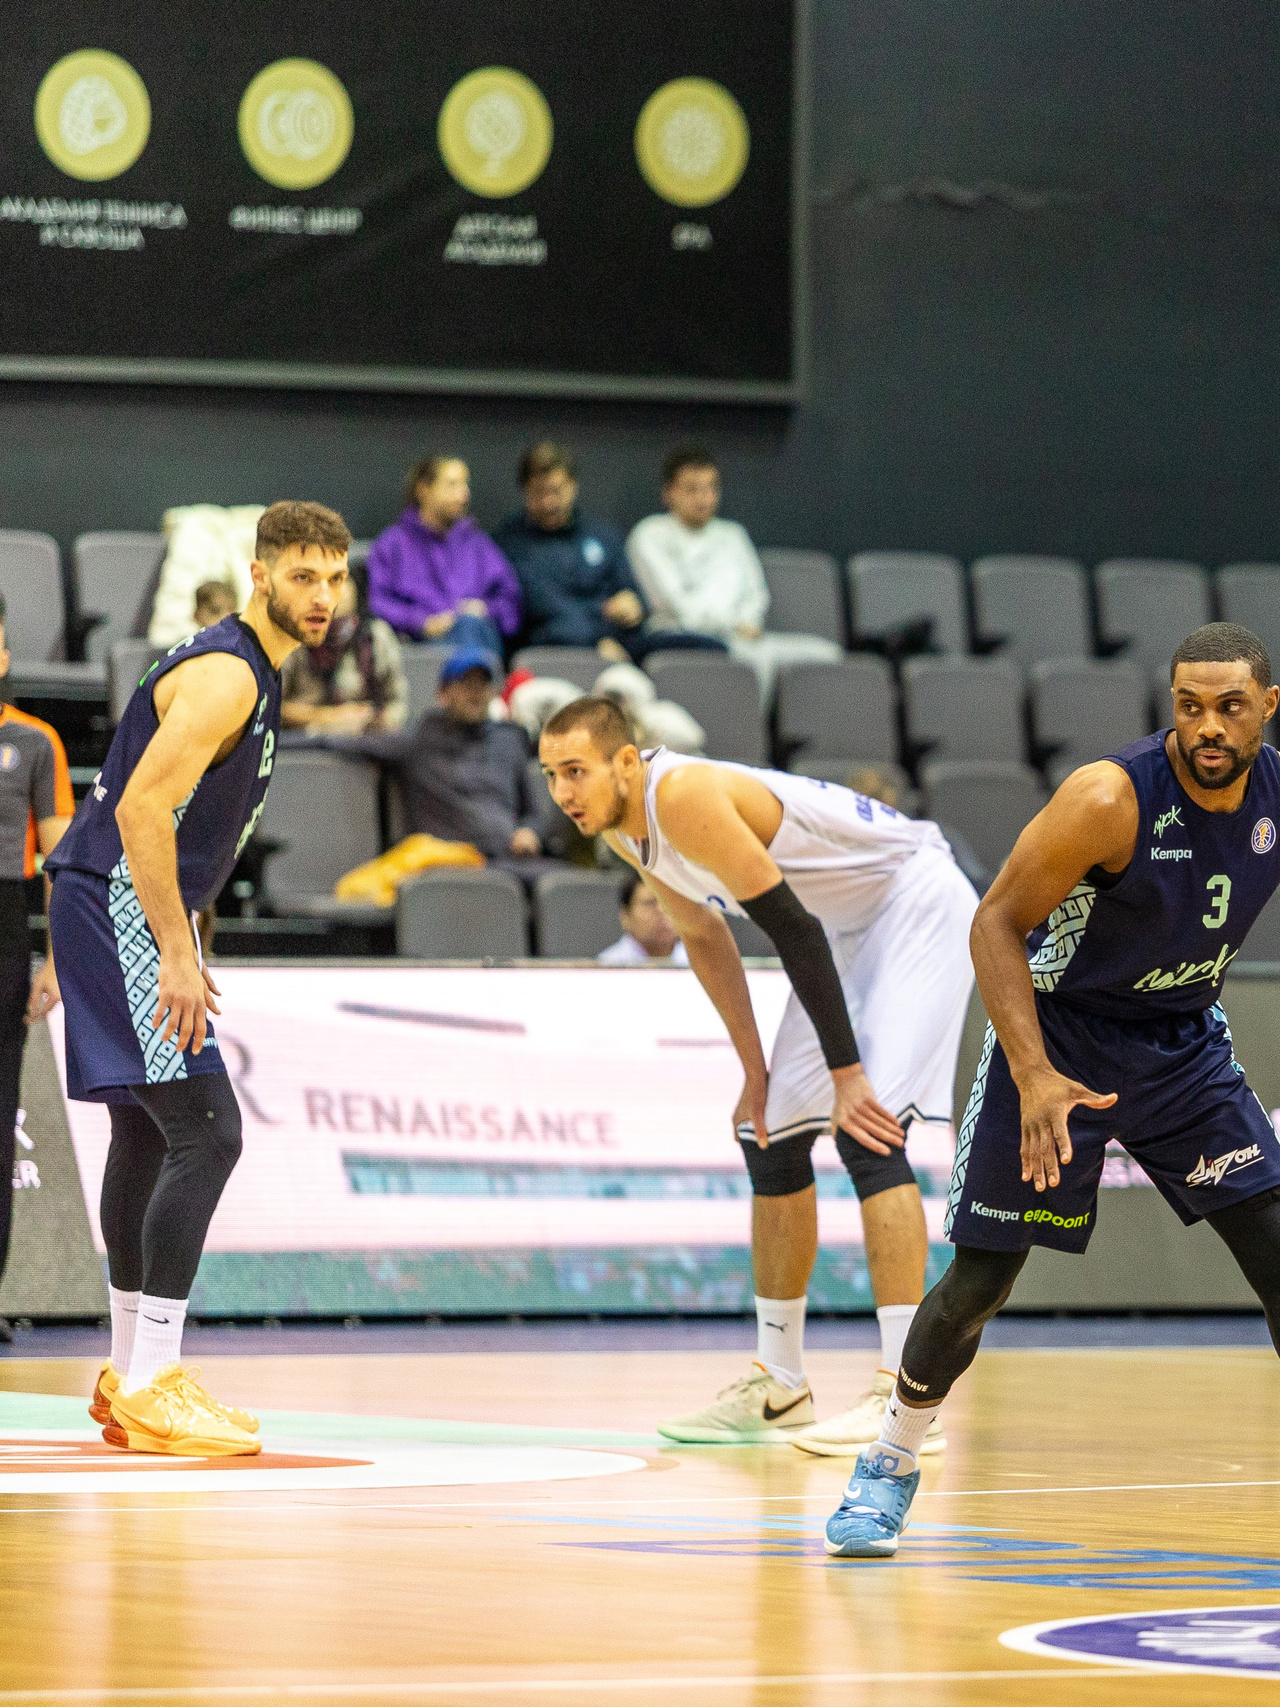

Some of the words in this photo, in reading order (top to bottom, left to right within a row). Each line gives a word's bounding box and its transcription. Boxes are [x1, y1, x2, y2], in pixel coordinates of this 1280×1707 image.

[1150, 847, 1193, 862] Kempa
[1202, 874, 1232, 929] 3
[302, 1085, 618, 1149] RENAISSANCE
[969, 1200, 1020, 1222] Kempa
